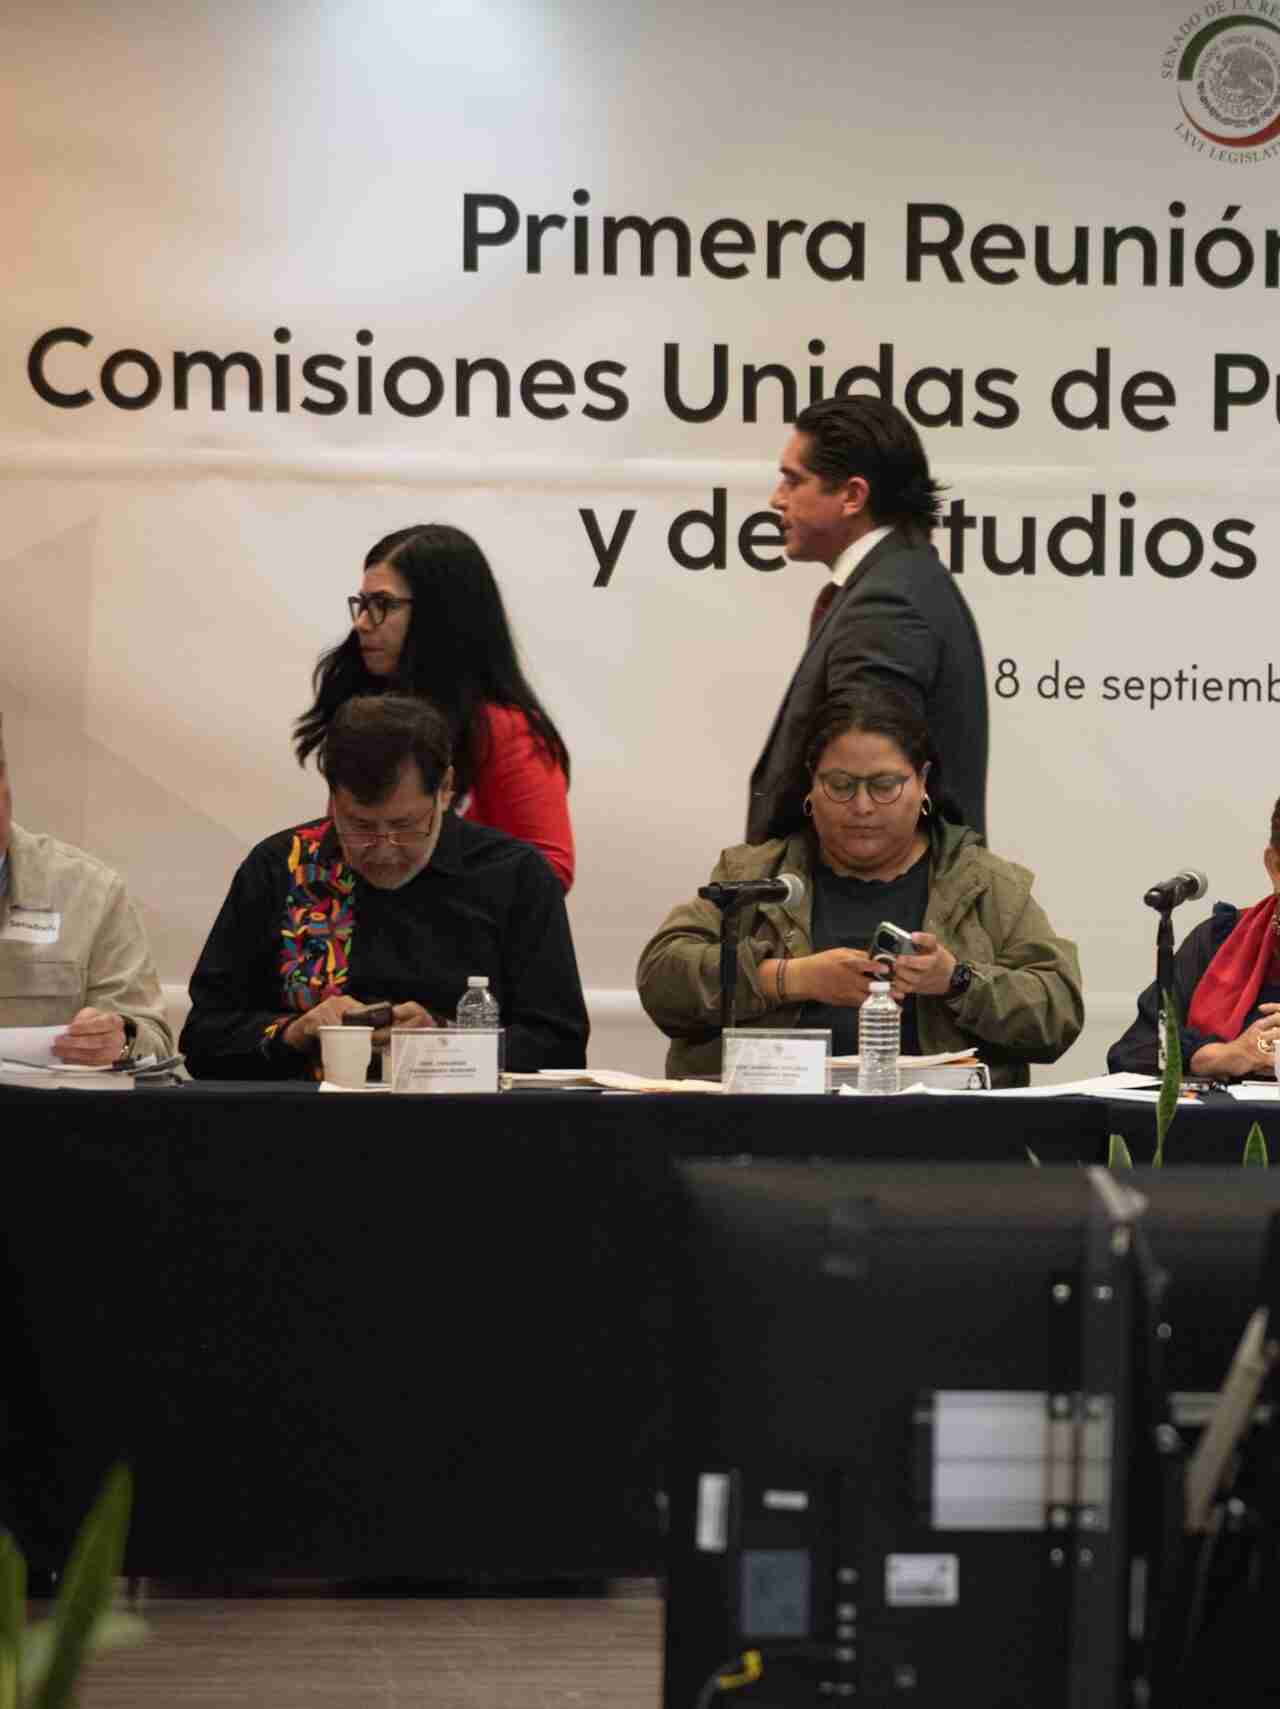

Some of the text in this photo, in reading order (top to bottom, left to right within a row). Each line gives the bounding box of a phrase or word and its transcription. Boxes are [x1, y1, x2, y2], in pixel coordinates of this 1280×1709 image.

[1161, 13, 1201, 80] SENADO
[1204, 0, 1226, 17] DE
[1231, 0, 1255, 10] LA
[1173, 122, 1208, 153] LXVI
[464, 189, 865, 281] Primera
[27, 327, 628, 421] Comisiones
[1052, 348, 1176, 431] de
[579, 509, 636, 587] y
[668, 488, 787, 571] de
[942, 490, 1256, 579] tudios
[1038, 660, 1085, 699] de
